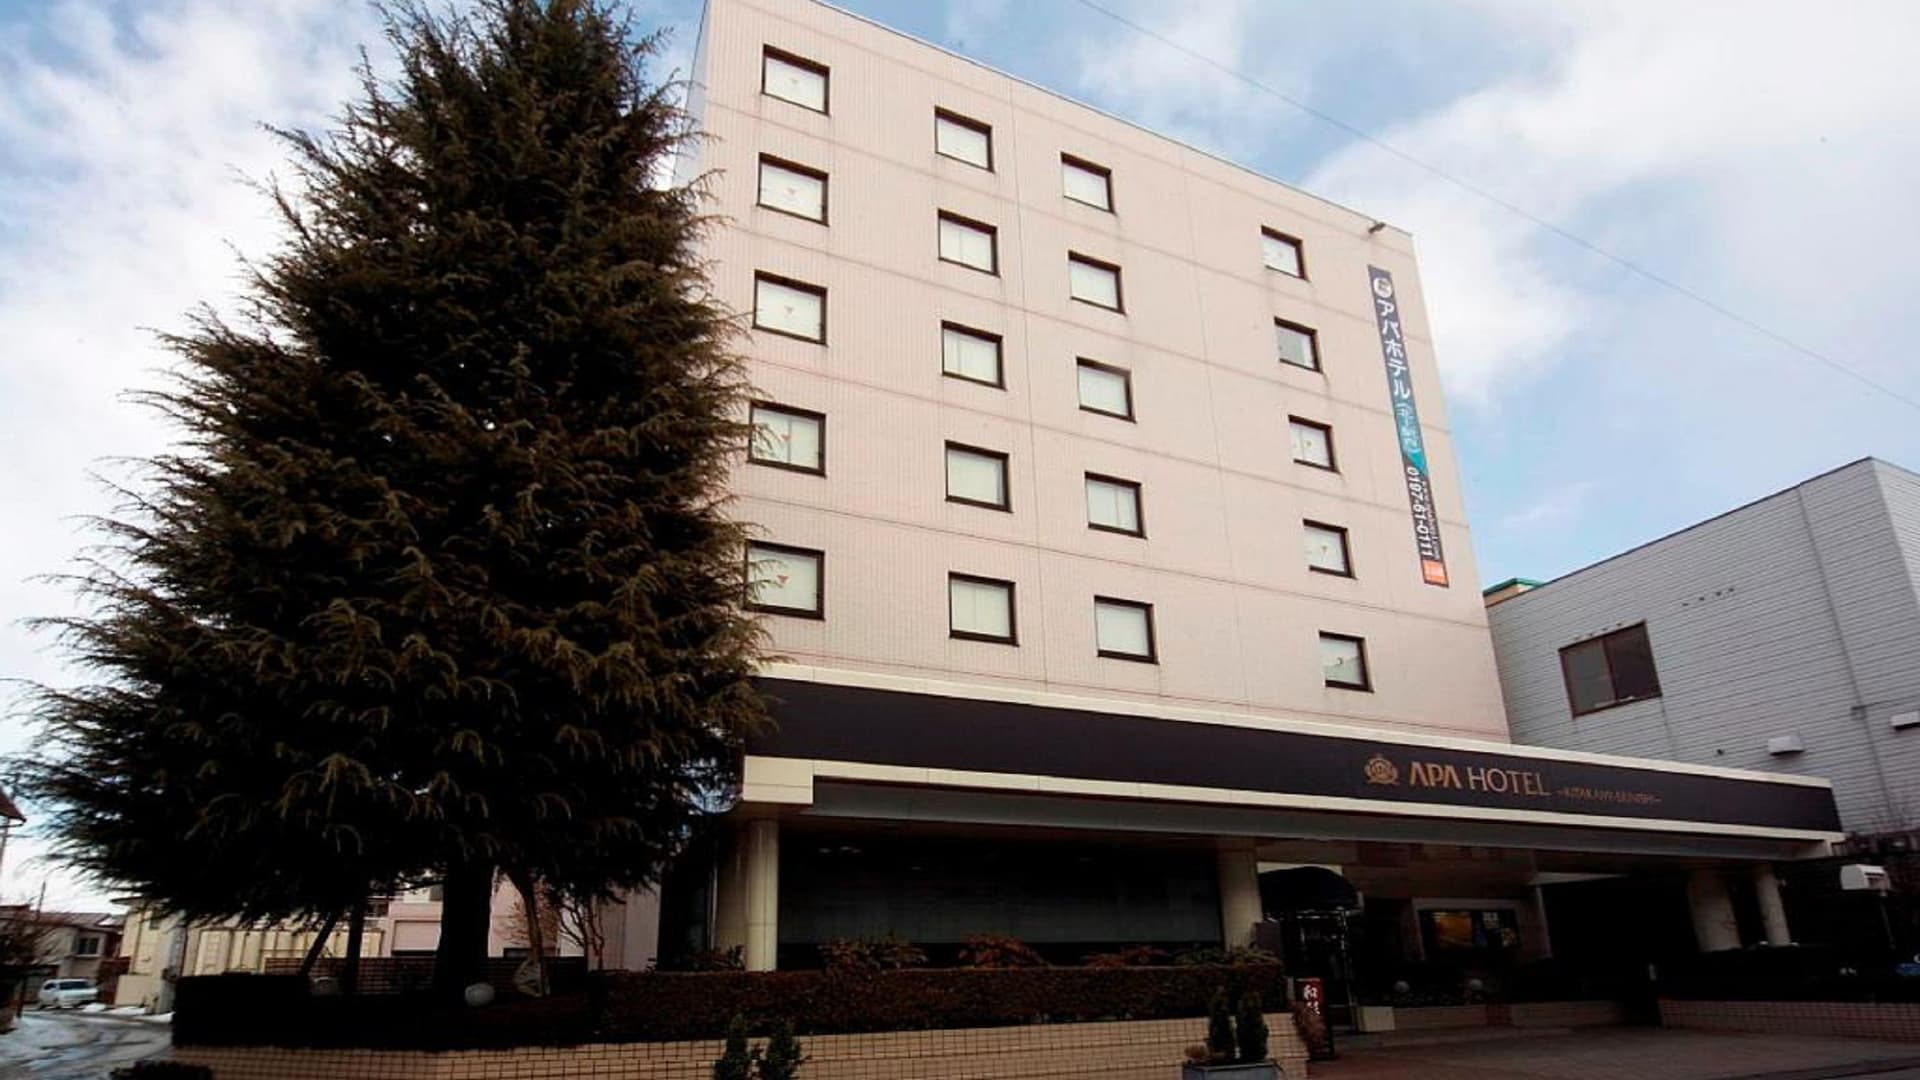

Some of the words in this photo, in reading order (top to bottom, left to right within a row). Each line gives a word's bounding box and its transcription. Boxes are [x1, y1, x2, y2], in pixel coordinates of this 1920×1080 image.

[1377, 299, 1410, 399] アパホテル
[1409, 761, 1463, 789] APA
[1467, 766, 1552, 796] HOTEL
